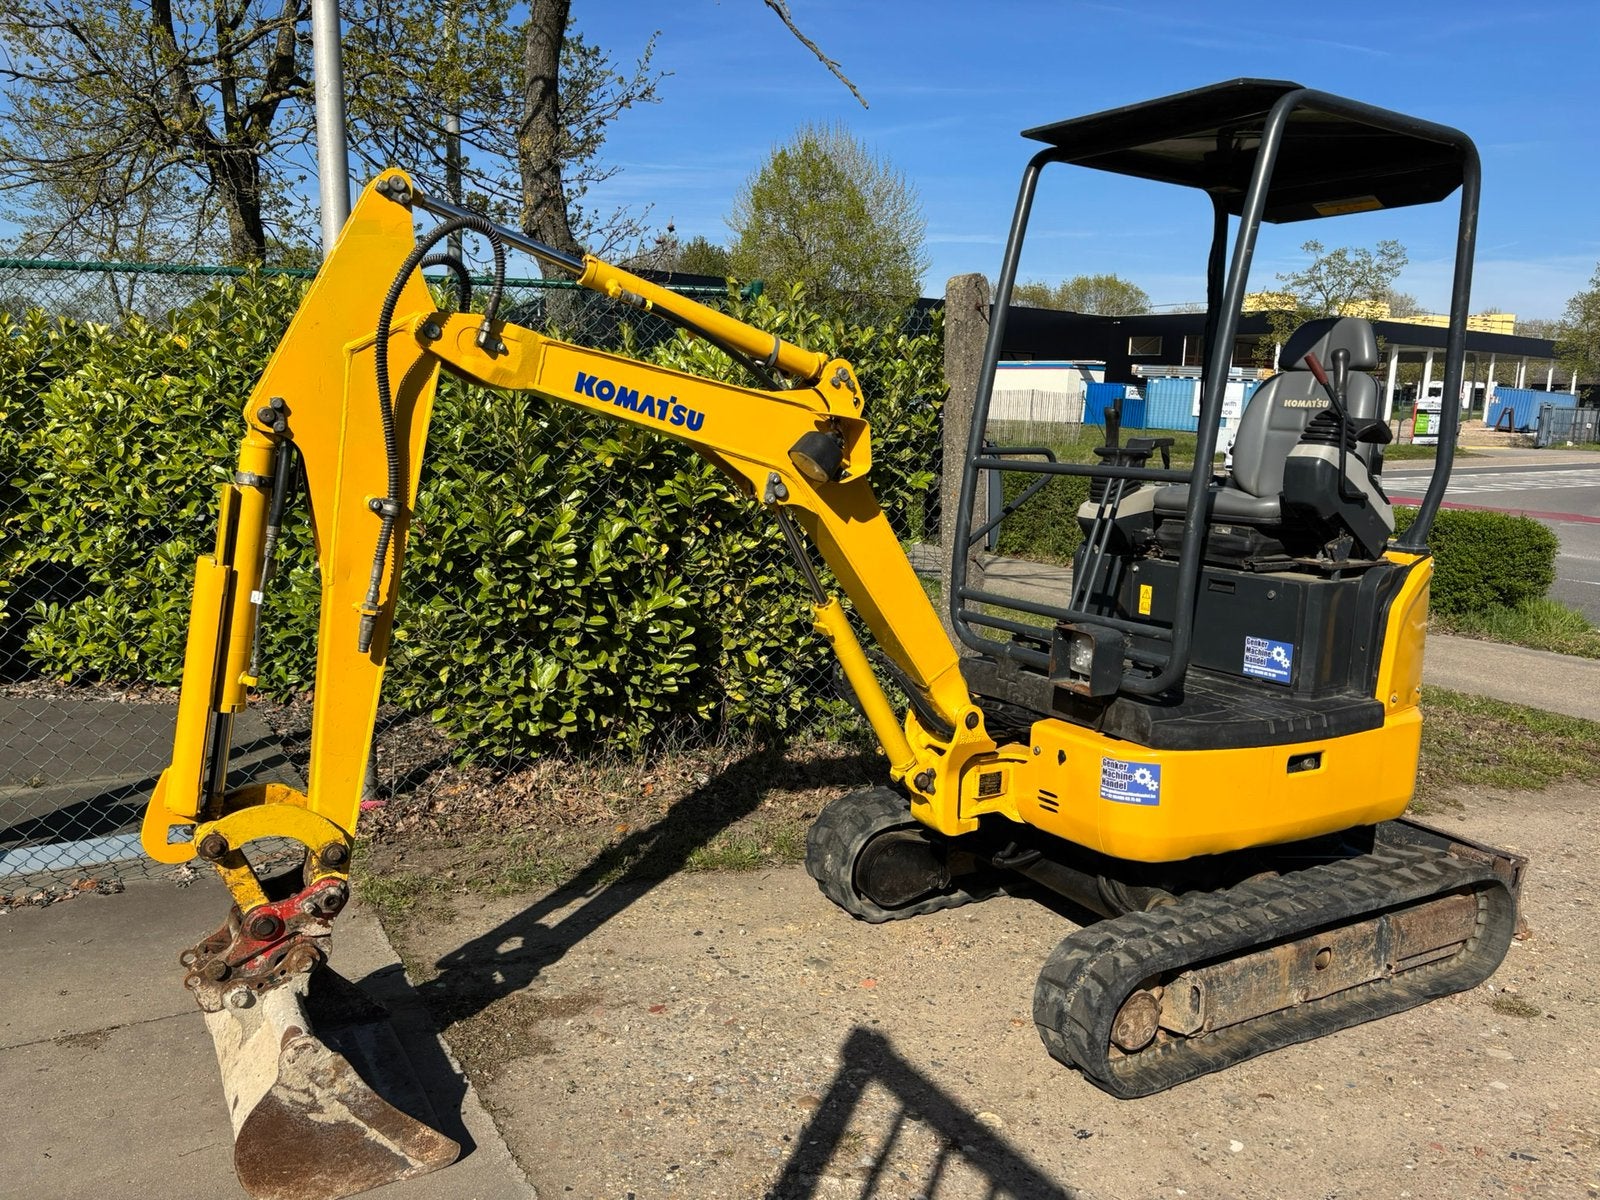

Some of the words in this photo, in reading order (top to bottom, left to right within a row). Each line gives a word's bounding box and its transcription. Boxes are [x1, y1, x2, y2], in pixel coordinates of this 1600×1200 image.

[574, 371, 705, 431] KOMATSU
[1283, 398, 1329, 408] KOMATSU
[1246, 637, 1268, 648] Genker
[1246, 646, 1271, 658] Machine
[1245, 655, 1267, 666] Handel
[1102, 758, 1128, 771] Genker
[1102, 768, 1133, 781] Machine
[1101, 778, 1127, 790] Handel
